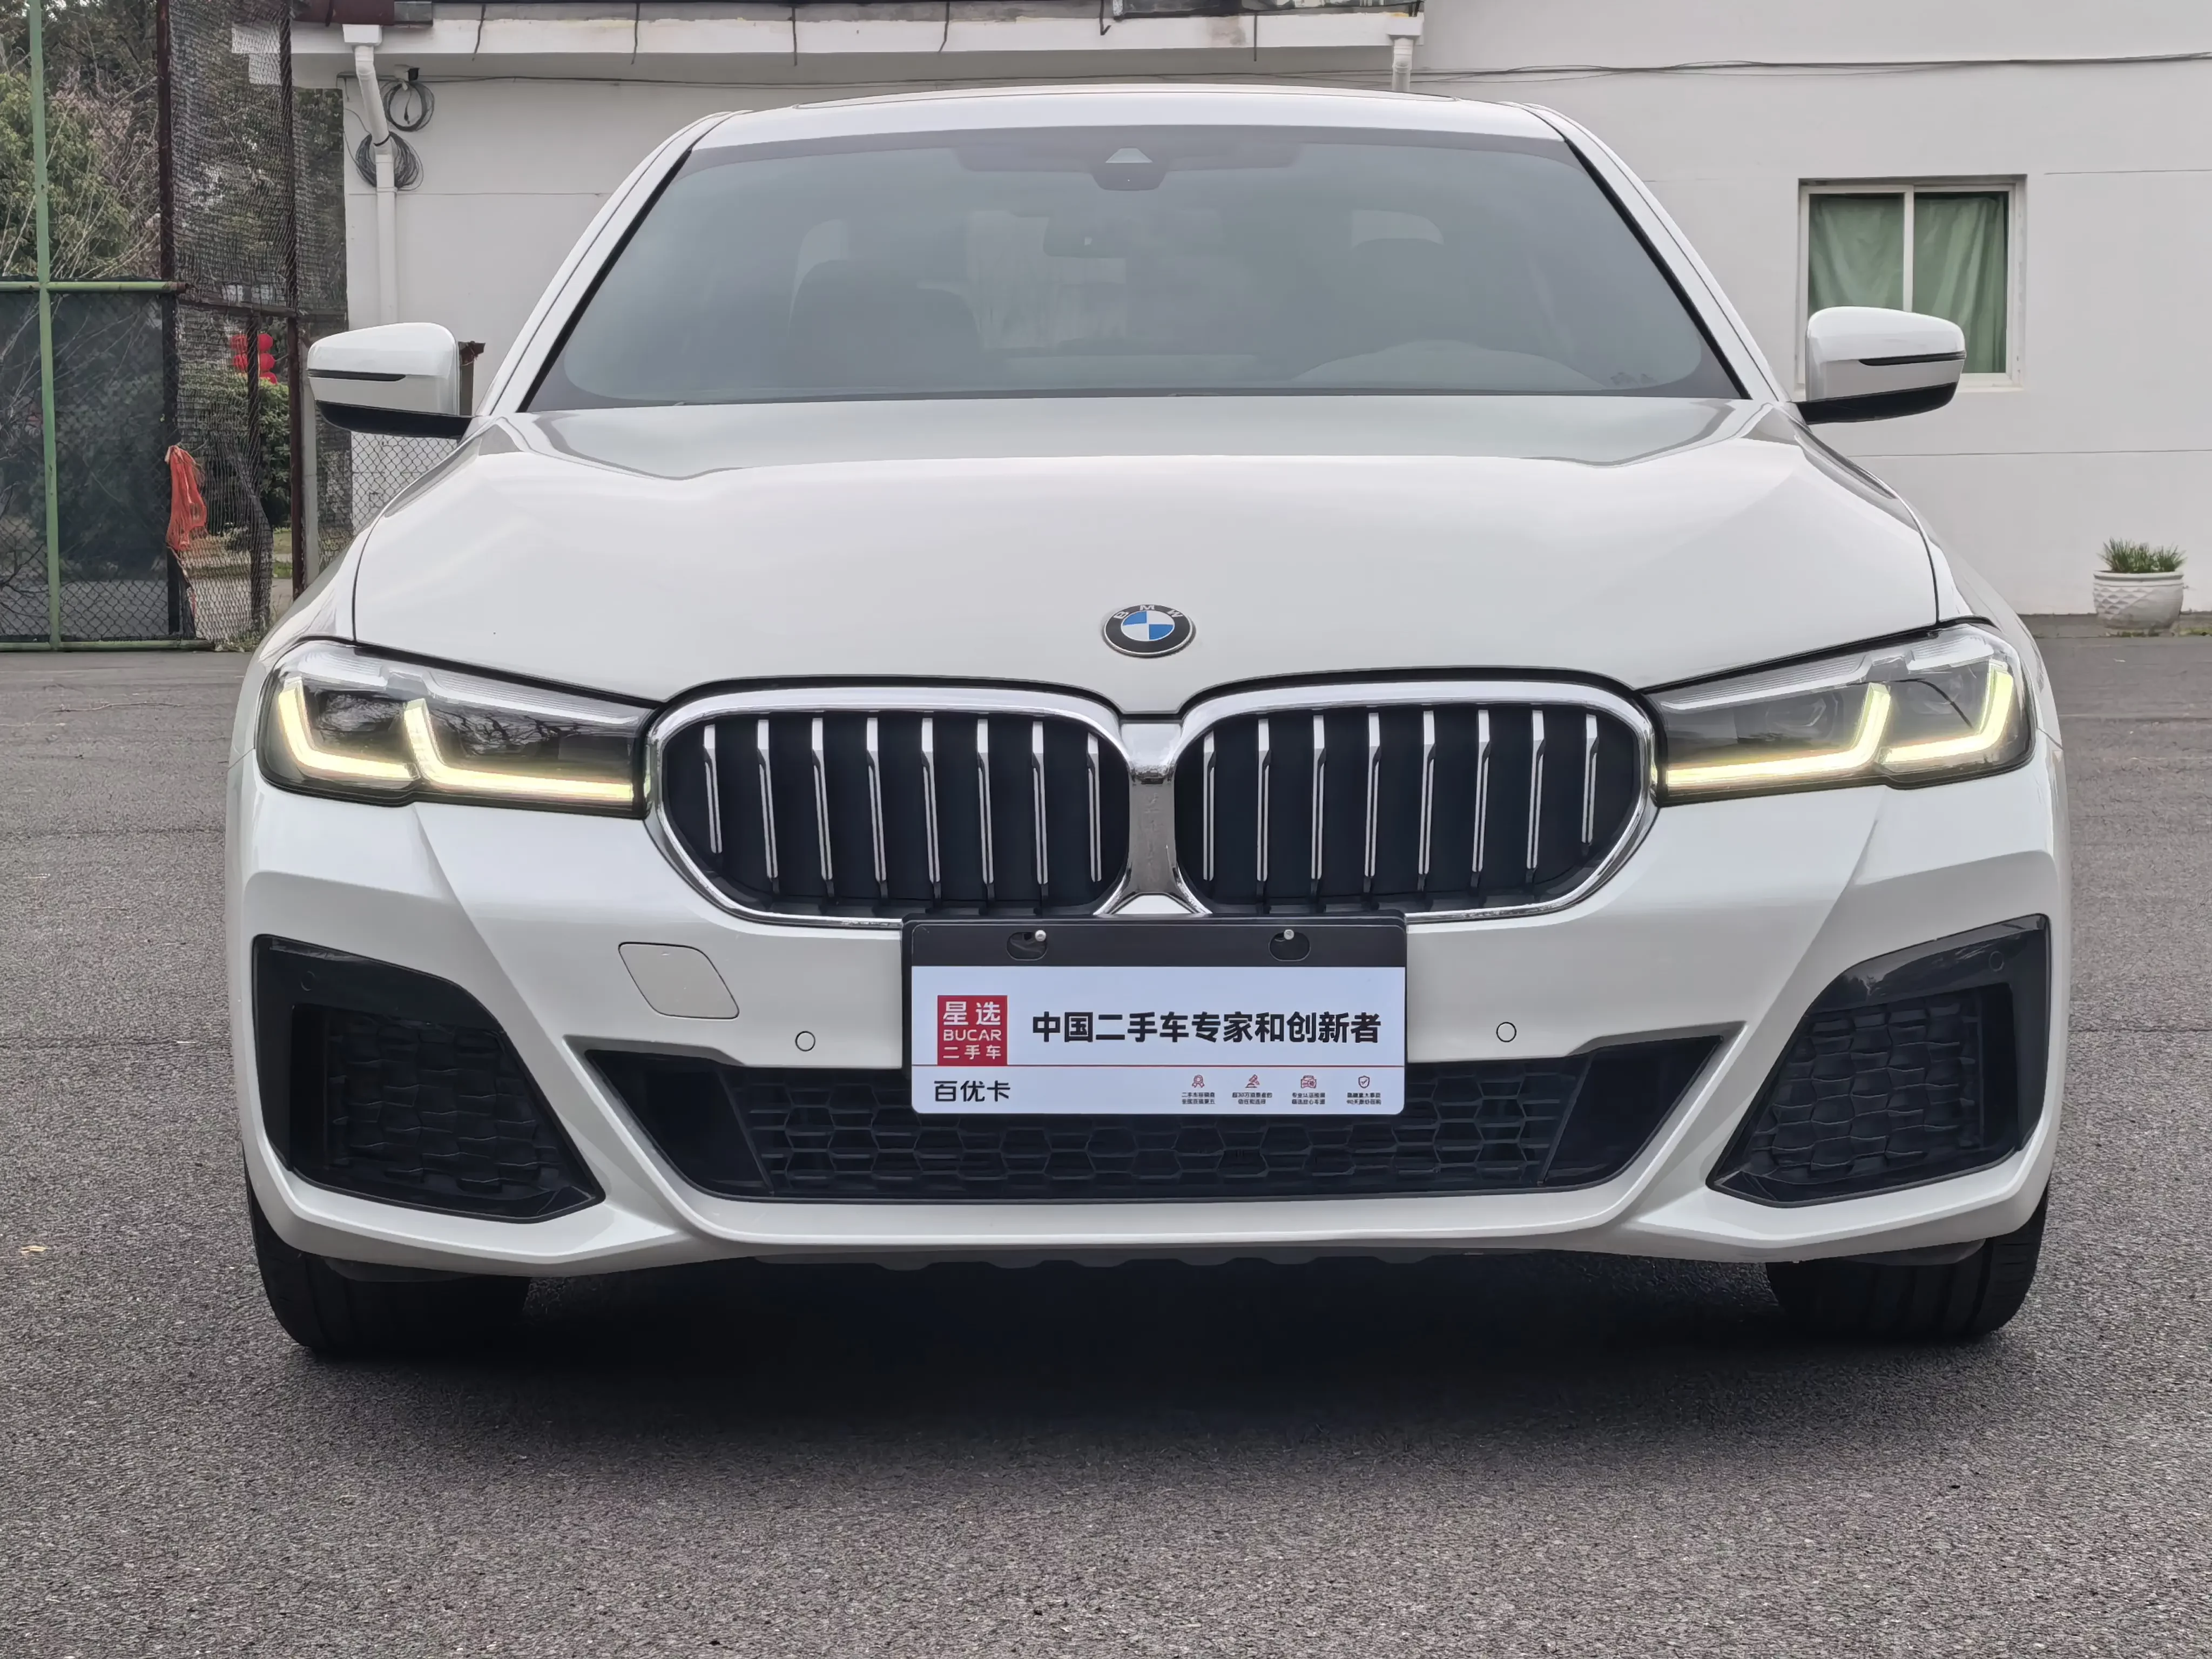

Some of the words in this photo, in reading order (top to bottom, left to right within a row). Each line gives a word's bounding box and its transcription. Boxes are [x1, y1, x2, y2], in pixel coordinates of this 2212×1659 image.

[1114, 604, 1183, 619] BMW
[943, 1001, 1001, 1025] 星选
[943, 1029, 1001, 1041] BUCAR
[1033, 1011, 1381, 1043] 中国二手车专家和创新者
[943, 1044, 1001, 1060] 二手车
[934, 1080, 1011, 1102] 百优卡
